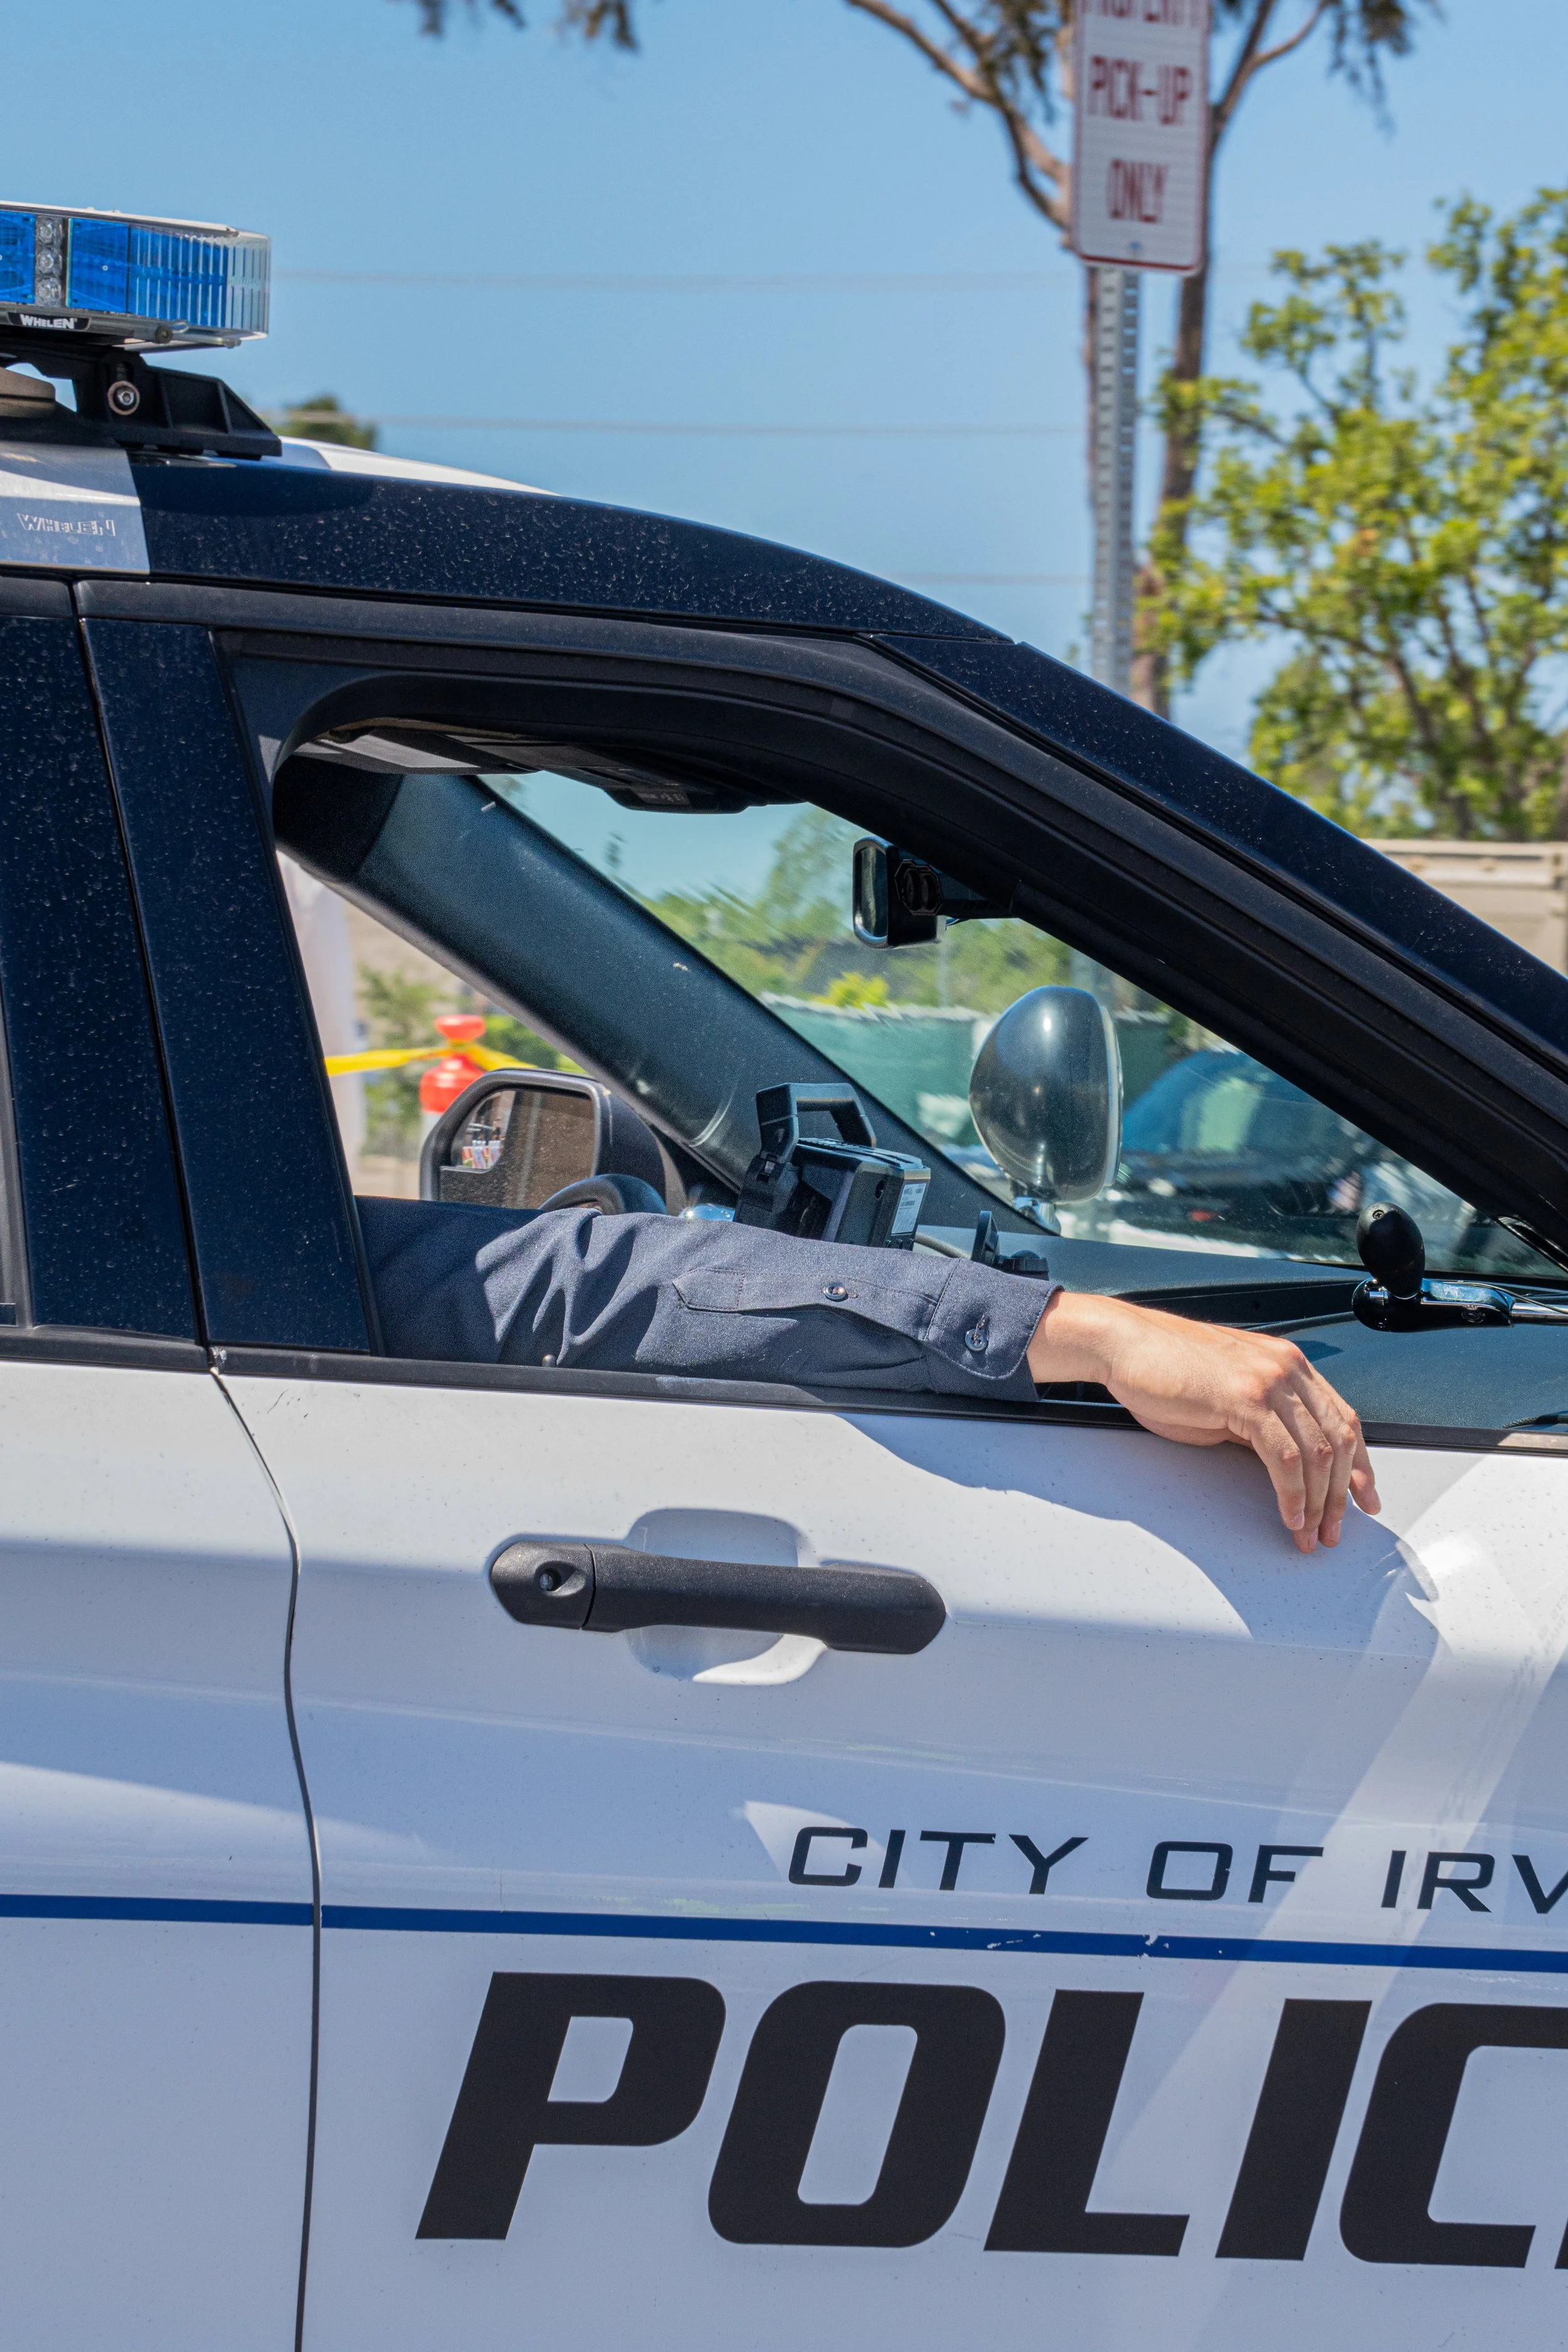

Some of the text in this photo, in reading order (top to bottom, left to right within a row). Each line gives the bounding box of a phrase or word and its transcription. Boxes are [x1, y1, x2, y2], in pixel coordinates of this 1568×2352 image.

[1088, 56, 1189, 126] PICK-UP
[1107, 159, 1168, 224] ONLY
[20, 314, 75, 329] WHELEN
[16, 512, 115, 536] WHELEN
[788, 1826, 1568, 1914] CITY OF IRV
[415, 1971, 1568, 2270] POLIC
